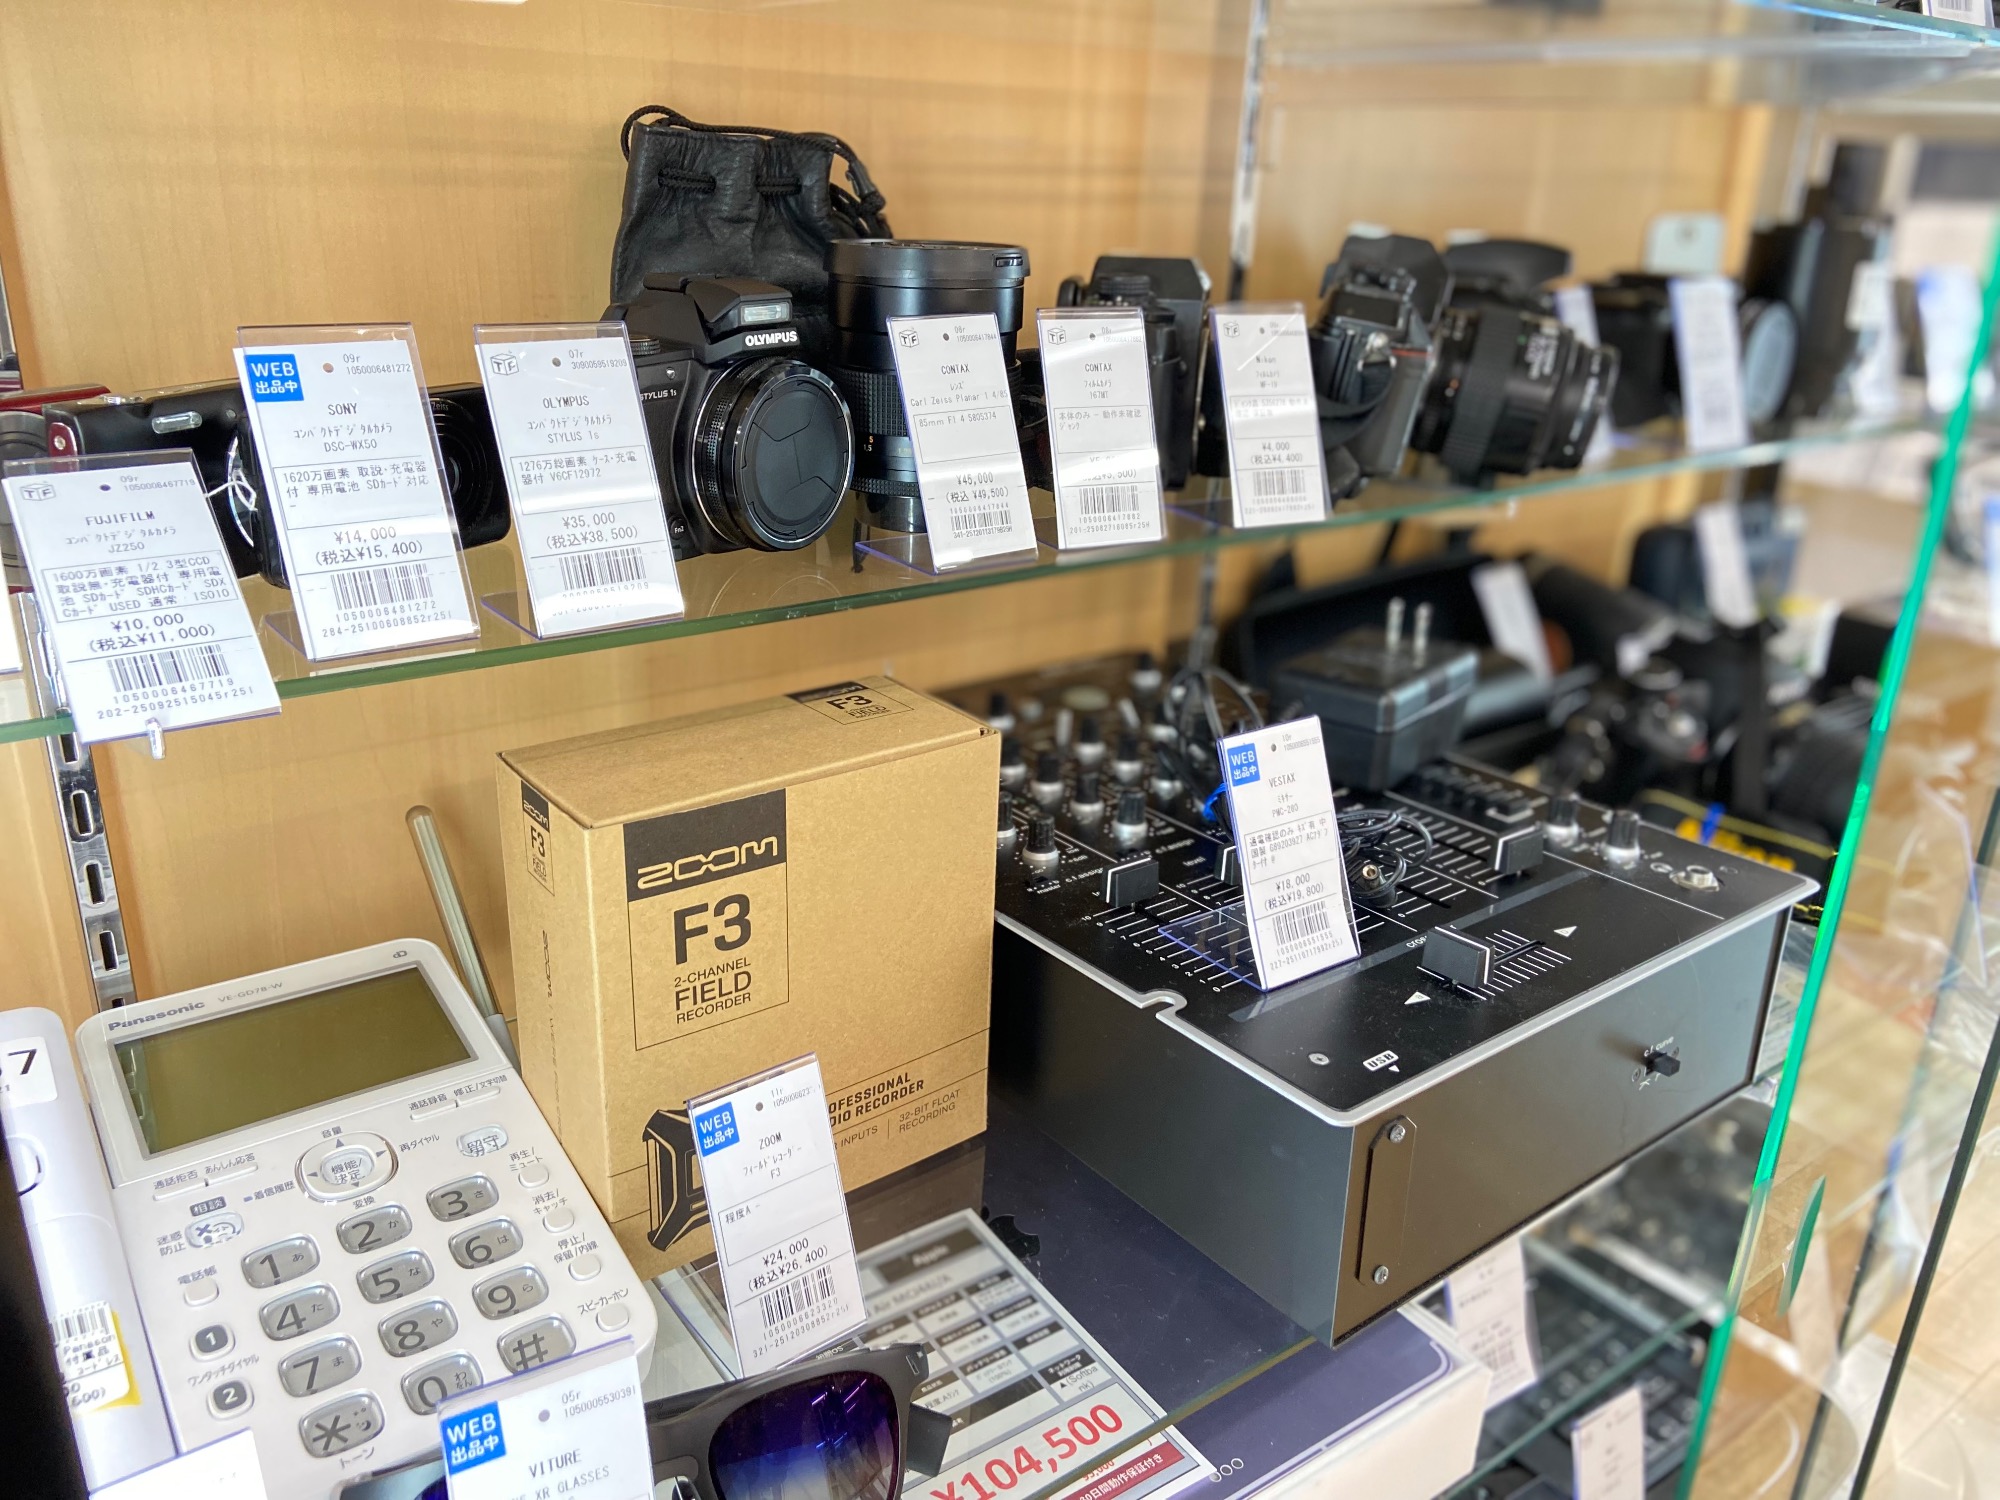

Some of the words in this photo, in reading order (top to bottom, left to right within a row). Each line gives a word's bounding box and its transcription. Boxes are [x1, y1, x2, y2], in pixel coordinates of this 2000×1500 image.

[745, 331, 798, 347] OLYMPUS
[343, 353, 360, 363] 09r
[568, 349, 584, 359] 07r
[251, 361, 295, 377] WEB
[346, 363, 411, 376] 1050006481272
[941, 363, 970, 375] CONTAX
[1084, 363, 1113, 372] CONTAX
[256, 380, 298, 394] 出品中
[328, 403, 358, 415] SONY
[543, 395, 590, 409] OLYMPUS
[910, 398, 927, 407] Carl
[931, 396, 953, 405] Zeiss
[955, 393, 980, 403] Planar
[919, 418, 944, 428] 85mm
[1059, 410, 1091, 420] 本体のみ
[324, 439, 377, 452] DSC-WX50
[548, 432, 583, 444] STYLUS
[588, 430, 600, 440] 1s
[283, 468, 350, 484] 1620万画素
[521, 472, 544, 486] 器付
[287, 486, 298, 499] 付
[307, 480, 360, 497] 専用電池
[405, 474, 429, 487] 対応
[85, 511, 156, 526] FUJIFILM
[108, 542, 145, 554] JZ250
[52, 565, 129, 582] 1600万画素
[177, 567, 222, 581] 専用電
[204, 578, 227, 589] SDX
[109, 600, 141, 612] USED
[149, 594, 178, 607] 通常
[113, 677, 234, 705] 1050006467719
[826, 695, 873, 709] F3
[1231, 751, 1255, 766] WEB
[1233, 765, 1257, 780] 出品中
[1269, 773, 1296, 788] VESTAX
[523, 799, 549, 829] ZOOM
[530, 825, 546, 857] F3
[637, 836, 778, 890] ZOOM
[1037, 884, 1061, 894] master
[673, 894, 751, 965] F3
[674, 957, 751, 987] 2-CHANNEL
[675, 970, 752, 1011] FIELD
[108, 1001, 206, 1031] Panasonic
[676, 992, 751, 1024] RECORDER
[1368, 1053, 1394, 1069] USB
[408, 1093, 448, 1112] 通話録音
[856, 1079, 924, 1117] RECORDER
[899, 1103, 929, 1122] 32-BIT
[932, 1089, 961, 1108] FLOAT
[699, 1111, 733, 1134] WEB
[899, 1102, 956, 1134] RECORDING
[321, 1126, 343, 1139] 音量
[703, 1127, 735, 1149] 出品中
[759, 1132, 783, 1150] ZOOM
[841, 1125, 878, 1147] INPUTS
[399, 1133, 441, 1152] 再ダイヤル
[466, 1134, 500, 1157] 留守
[509, 1147, 535, 1163] 再生/
[509, 1156, 544, 1171] ミュート
[331, 1159, 363, 1175] 機能/
[770, 1168, 781, 1180] F3
[153, 1169, 199, 1190] 通話拒否
[253, 1181, 295, 1200] 着信履歴
[353, 1196, 376, 1210] 変換
[440, 1190, 469, 1216] 3
[532, 1197, 568, 1215] キャッチ
[156, 1230, 184, 1246] 迷惑
[352, 1220, 382, 1249] 2
[387, 1217, 399, 1230] か
[557, 1232, 586, 1250] 停止/
[159, 1241, 187, 1257] 防止
[464, 1235, 493, 1263] 6
[497, 1234, 509, 1244] は
[259, 1253, 281, 1279] 1
[291, 1251, 305, 1263] あ
[177, 1265, 217, 1285] 電話帳
[372, 1267, 401, 1298] 5
[409, 1266, 421, 1277] な
[487, 1284, 516, 1314] 9
[522, 1283, 534, 1293] ら
[578, 1288, 629, 1315] スピーカーホン
[276, 1302, 307, 1331] 4
[311, 1302, 325, 1313] た
[205, 1332, 216, 1346] 1
[393, 1319, 426, 1350] 8
[431, 1317, 443, 1328] や
[187, 1354, 260, 1387] ワンタッチダイヤル
[293, 1355, 320, 1391] 7
[331, 1356, 344, 1367] ま
[417, 1375, 448, 1408] 0
[1079, 1380, 1094, 1392] nk)
[222, 1387, 239, 1404] 2
[562, 1391, 581, 1404] 05r
[564, 1386, 636, 1418] 1050005530391
[447, 1412, 497, 1445] WEB
[339, 1447, 375, 1469] トーン
[451, 1434, 499, 1466] 出品中
[529, 1448, 582, 1478] VITURE
[557, 1466, 610, 1494] GLASSES
